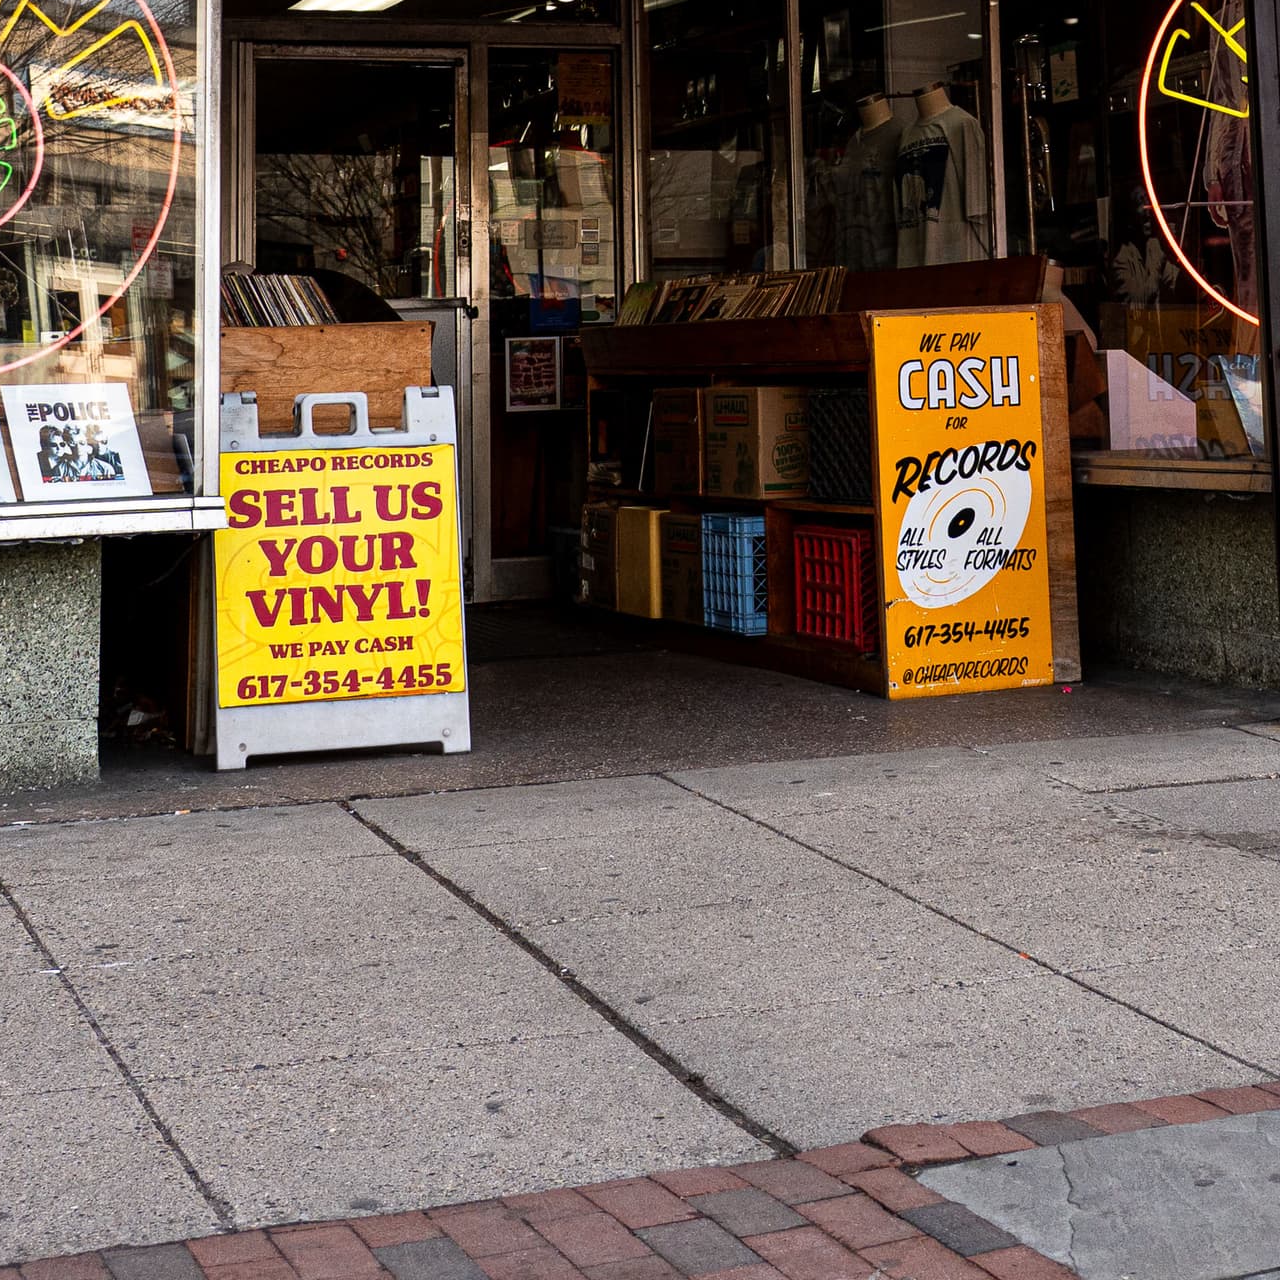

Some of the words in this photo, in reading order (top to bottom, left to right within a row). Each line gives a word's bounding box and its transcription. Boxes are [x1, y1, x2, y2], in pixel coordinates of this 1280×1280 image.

[919, 333, 946, 352] WE
[950, 332, 981, 352] PAY
[898, 356, 1021, 410] CASH
[26, 403, 40, 422] THE
[38, 401, 111, 421] POLICE
[945, 416, 968, 430] FOR
[235, 456, 326, 475] CHEAPO
[331, 452, 433, 471] RECORDS
[892, 439, 1037, 504] RECORDS
[228, 486, 362, 529] SELL
[373, 481, 443, 521] US
[900, 527, 925, 547] ALL
[976, 526, 1003, 546] ALL
[258, 531, 417, 577] YOUR
[896, 548, 947, 571] STYLES
[964, 548, 1037, 571] FORMATS
[245, 579, 431, 628] VINYL!
[904, 616, 1030, 648] 617-354-4455
[269, 642, 304, 659] WE
[308, 640, 350, 657] PAY
[354, 636, 414, 654] CASH
[237, 663, 452, 699] 617-354-4455
[903, 656, 1029, 685] @CHEAPORECORDS
